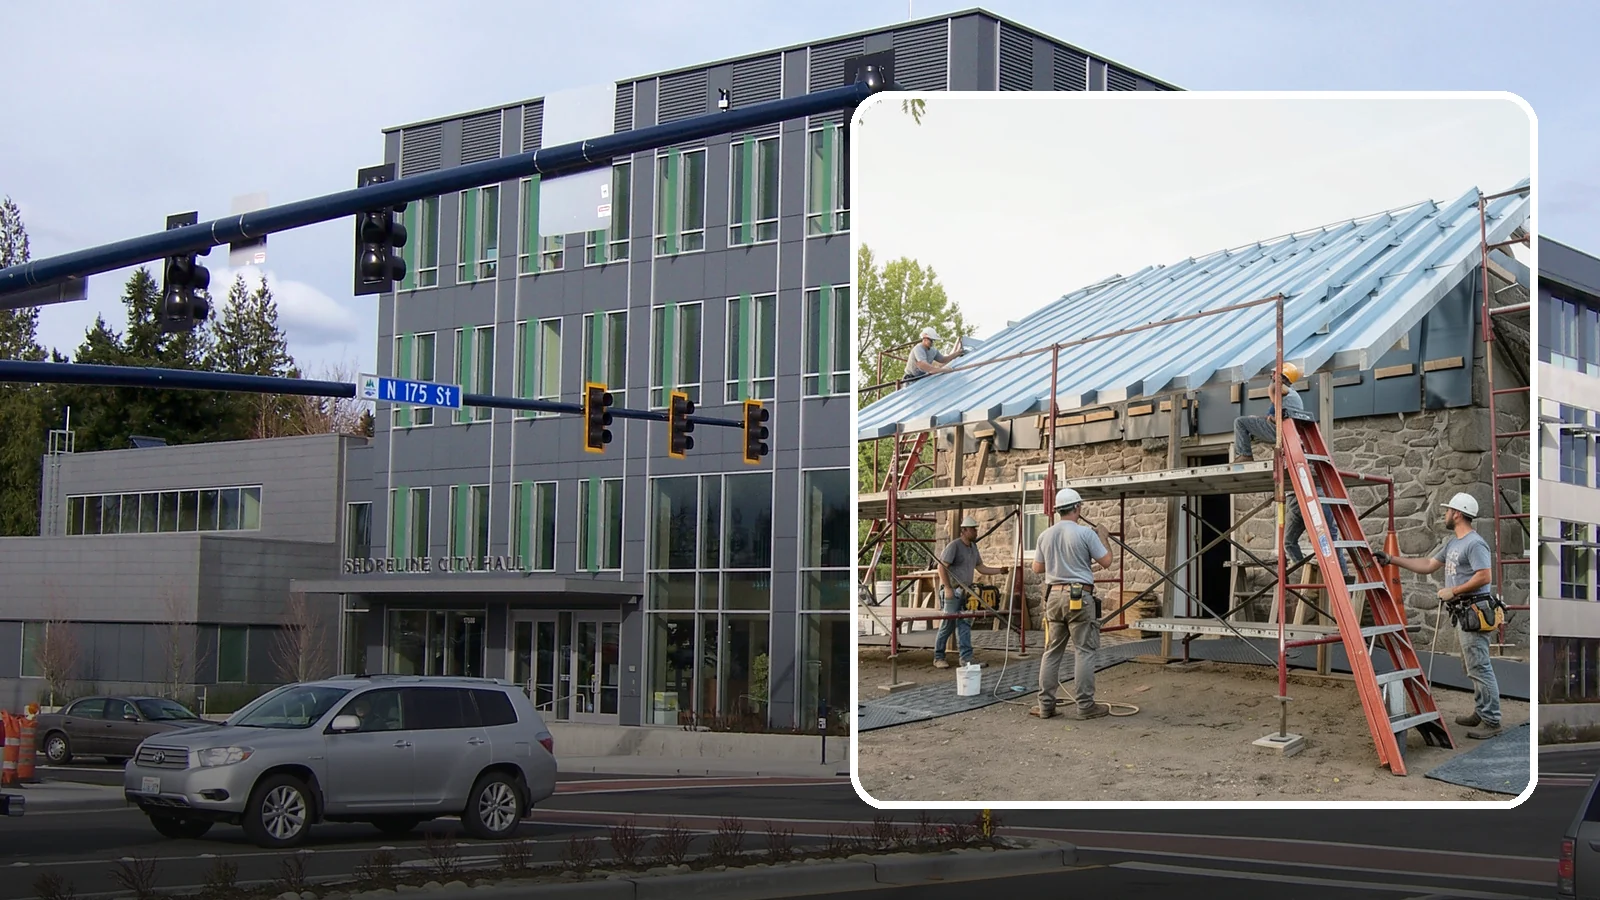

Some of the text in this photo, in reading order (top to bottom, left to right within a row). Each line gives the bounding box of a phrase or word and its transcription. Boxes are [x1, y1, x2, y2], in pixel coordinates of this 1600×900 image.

[387, 380, 451, 406] N 175 St
[343, 556, 525, 574] SHORELINE CITY HALL
